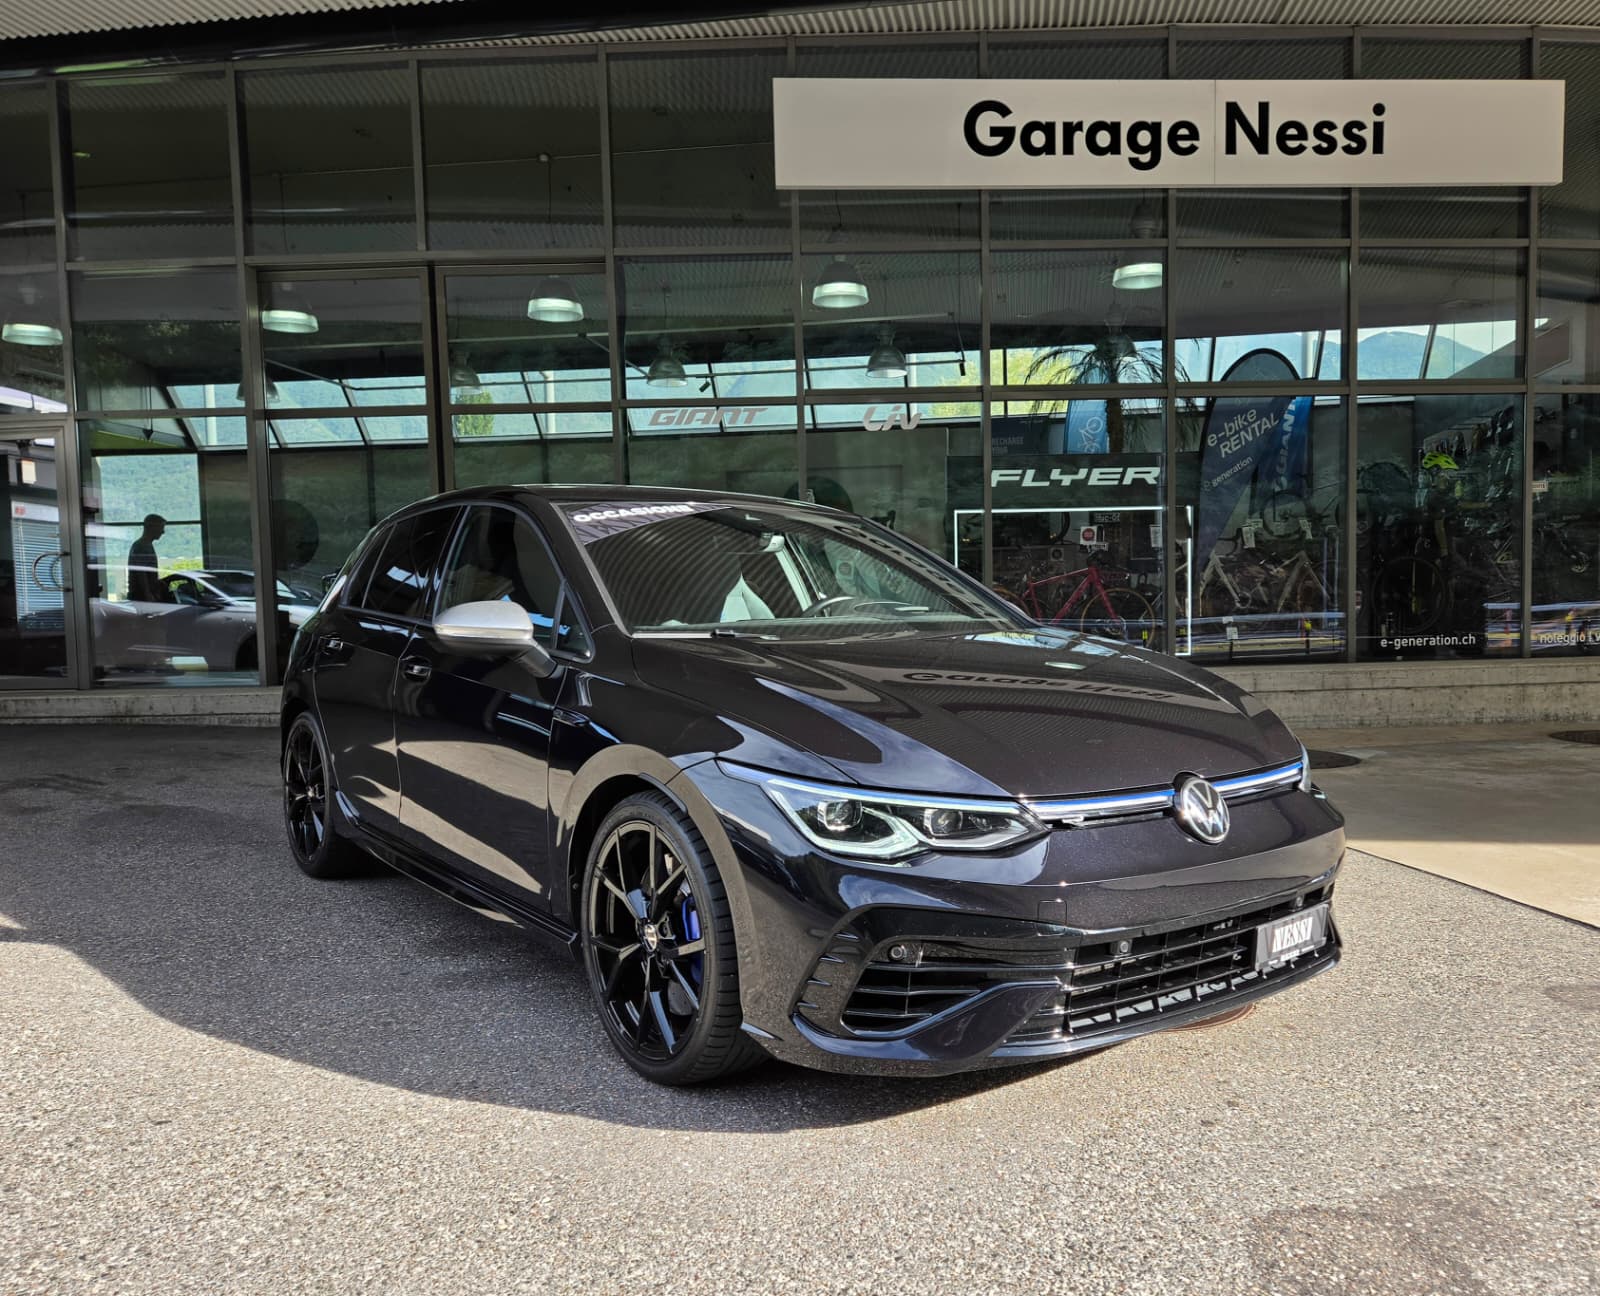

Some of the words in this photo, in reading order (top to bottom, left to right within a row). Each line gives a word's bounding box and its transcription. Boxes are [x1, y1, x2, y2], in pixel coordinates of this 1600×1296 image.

[963, 100, 1200, 170] Garage
[1224, 101, 1387, 156] Nessi
[648, 407, 768, 426] GIANT
[864, 405, 922, 432] Liv
[1207, 408, 1257, 447] e-bike
[1219, 412, 1279, 459] RENTAL
[990, 466, 1161, 488] FLYER
[1380, 633, 1476, 651] e-generation.ch
